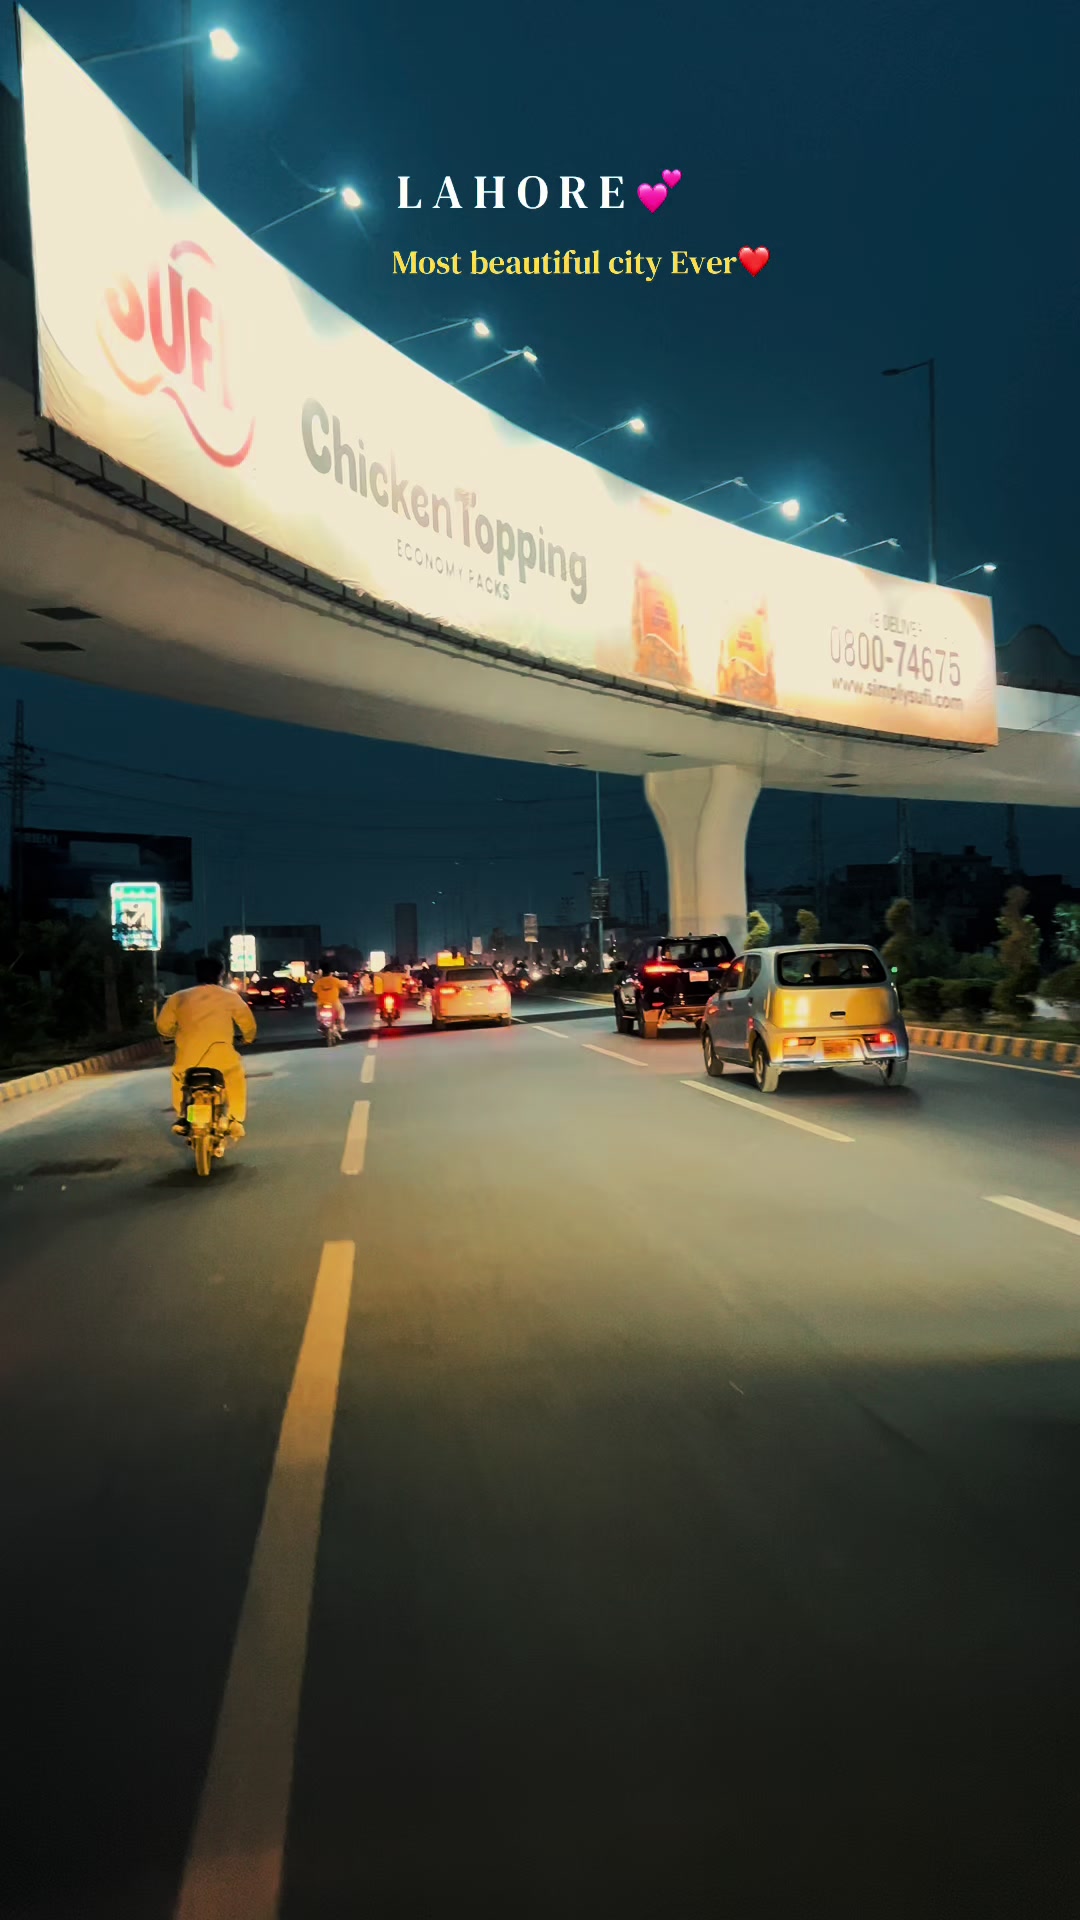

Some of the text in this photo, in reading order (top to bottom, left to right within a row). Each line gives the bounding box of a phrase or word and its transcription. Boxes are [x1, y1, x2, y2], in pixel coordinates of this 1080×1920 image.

[397, 538, 510, 601] ECONOMY PACKS
[830, 625, 961, 687] 0800-74675
[832, 678, 964, 711] www.simplysufi.com
